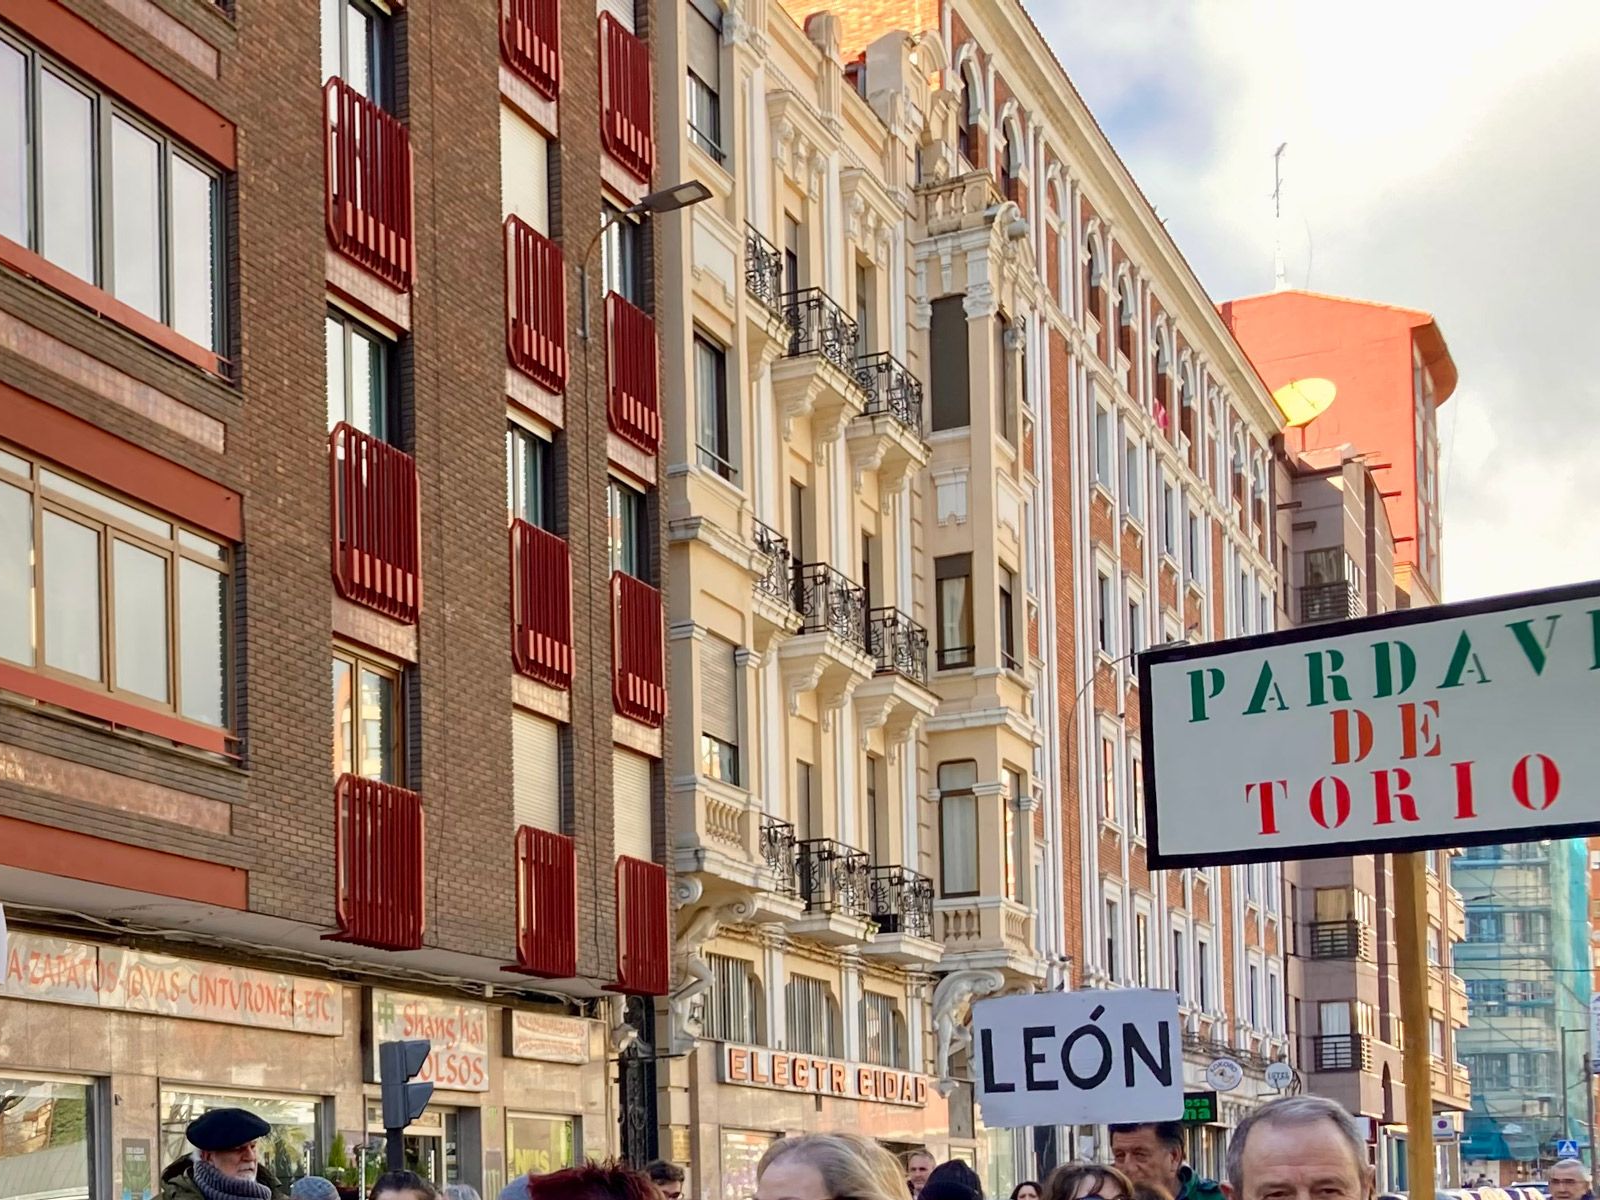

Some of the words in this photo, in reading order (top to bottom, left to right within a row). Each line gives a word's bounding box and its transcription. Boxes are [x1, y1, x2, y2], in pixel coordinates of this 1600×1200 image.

[1330, 700, 1442, 766] DE
[1245, 753, 1561, 836] TORIO
[403, 1000, 457, 1050] Shang
[459, 1006, 484, 1045] hai
[980, 1005, 1173, 1095] LEÓN
[419, 1053, 484, 1086] OLSOS
